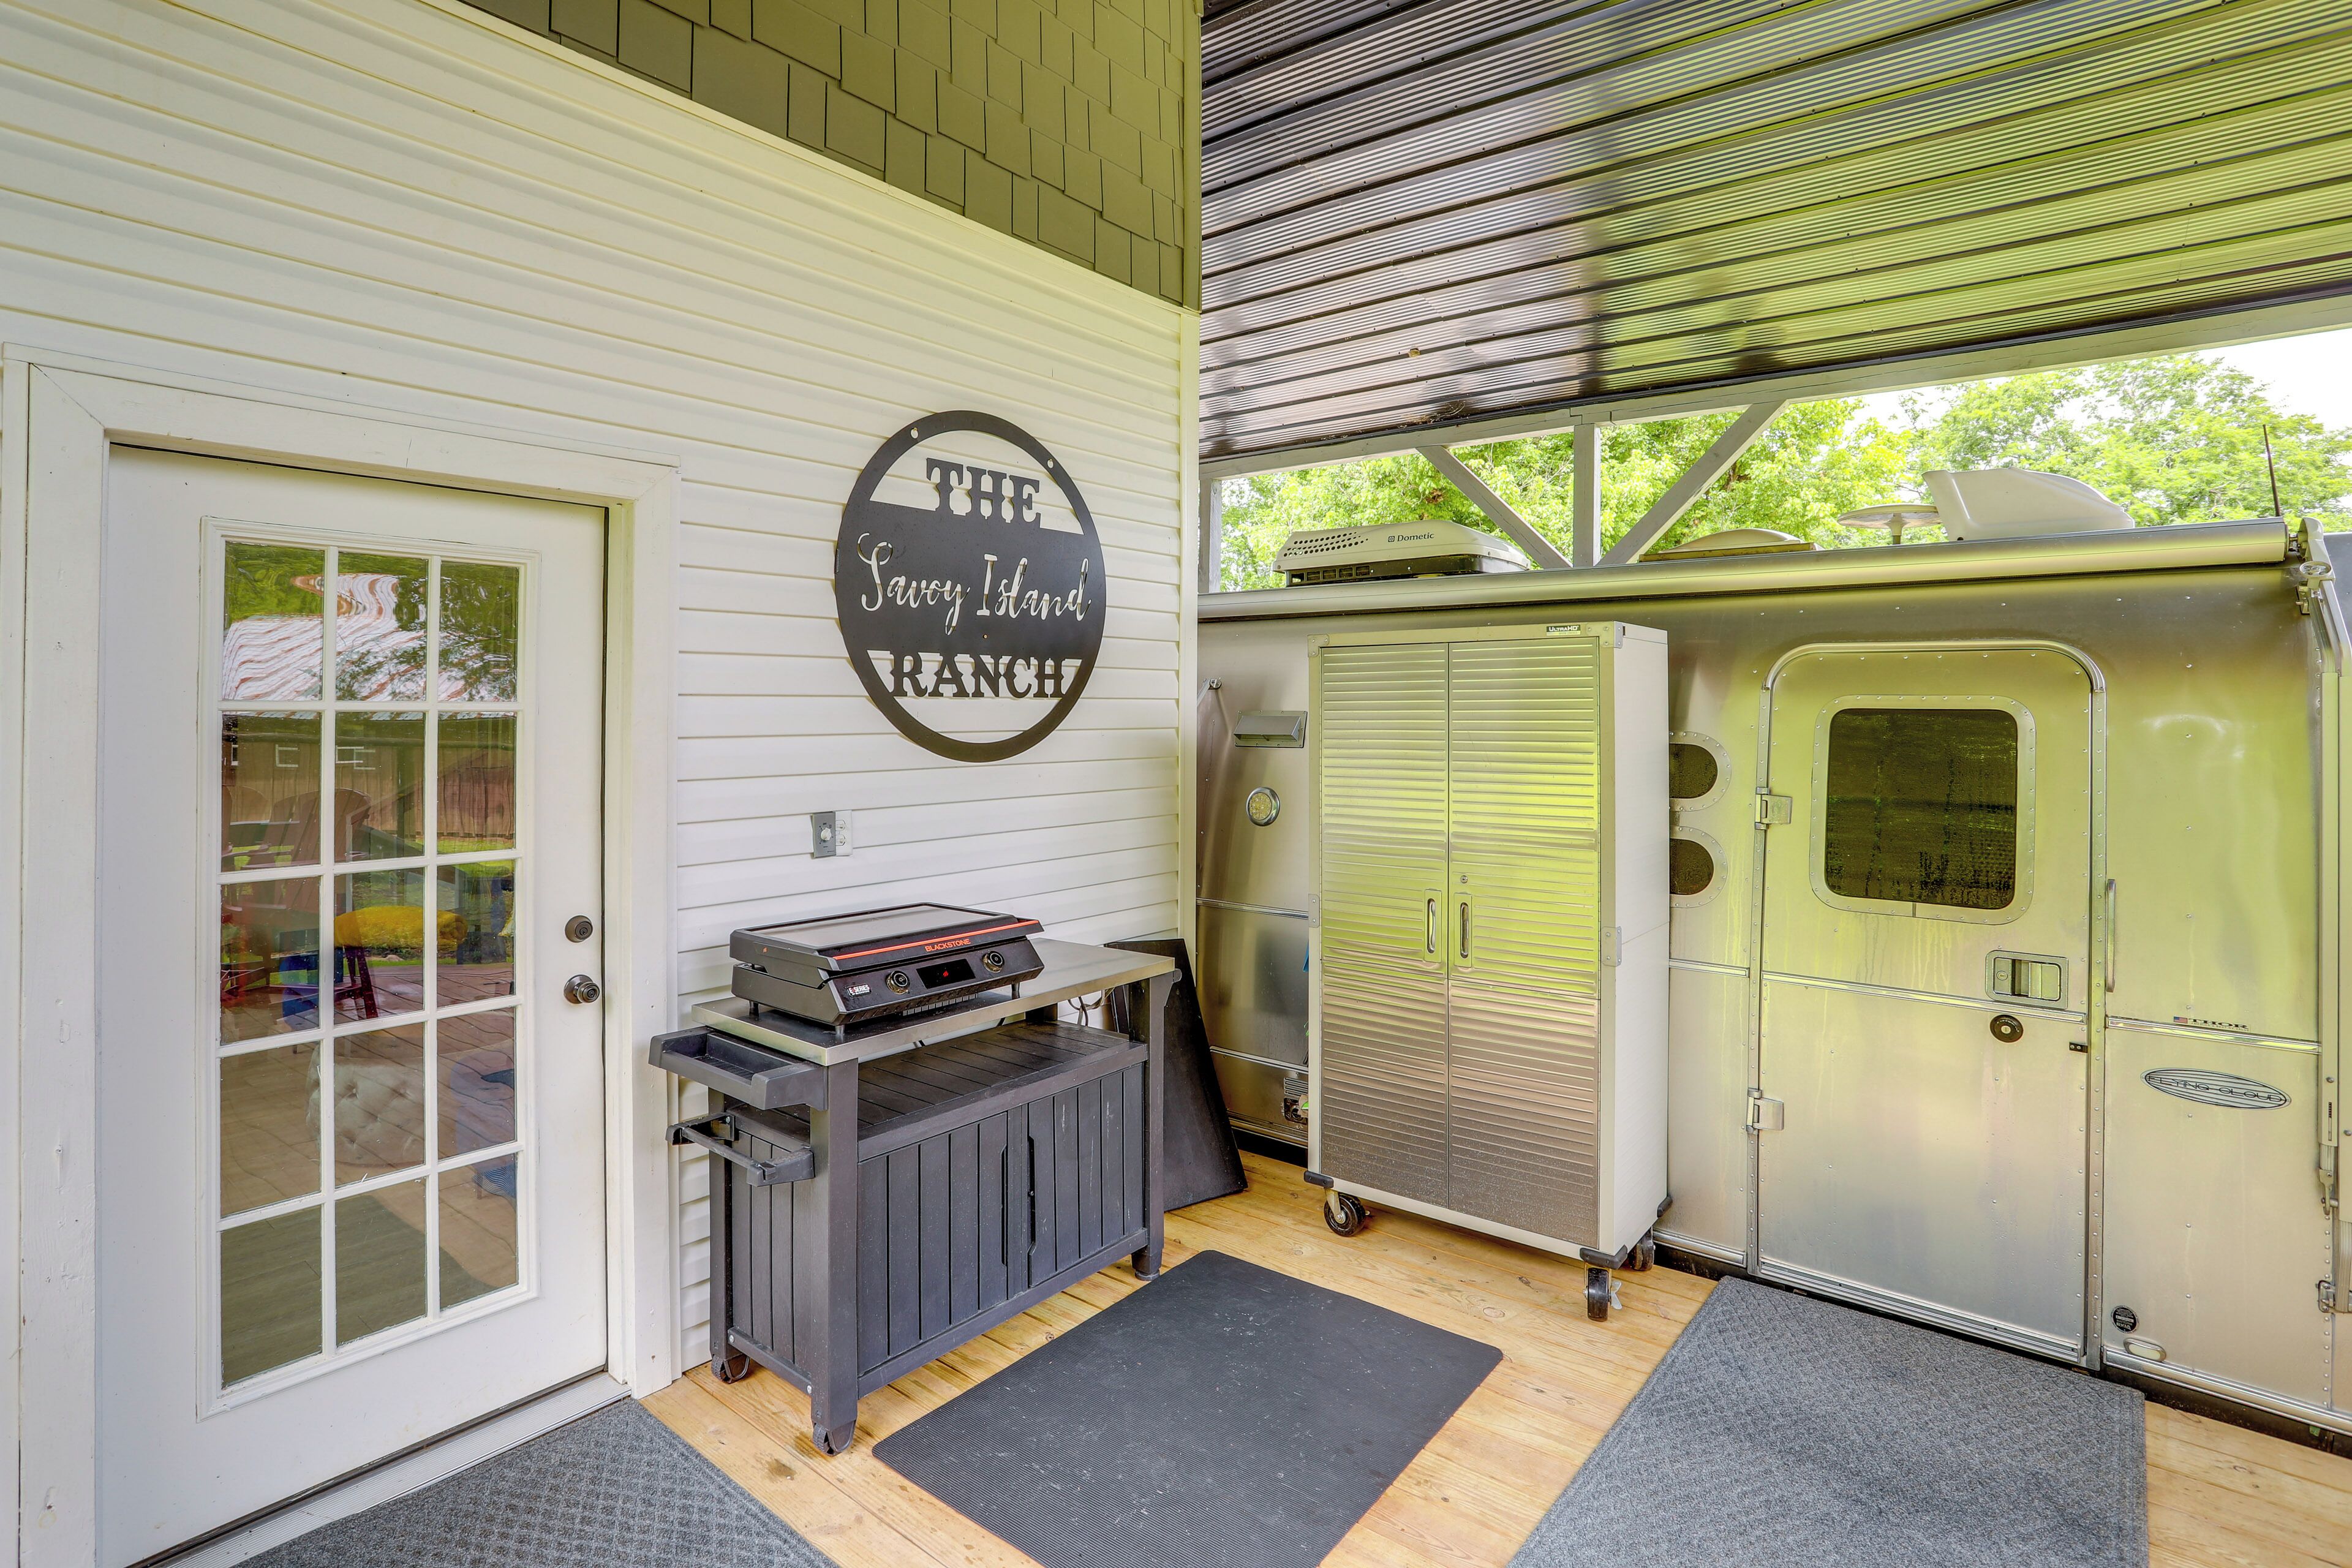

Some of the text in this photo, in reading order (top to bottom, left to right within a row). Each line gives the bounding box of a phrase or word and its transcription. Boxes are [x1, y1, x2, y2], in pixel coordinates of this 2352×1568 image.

[926, 457, 1041, 524] THE
[1397, 532, 1434, 542] Dometic
[858, 532, 1091, 635] Savoy Island
[890, 650, 1066, 699] RANCH
[924, 938, 971, 952] BLACKSTONE
[2188, 1018, 2249, 1030] THOR
[2148, 1075, 2283, 1102] FLYING CLOUD
